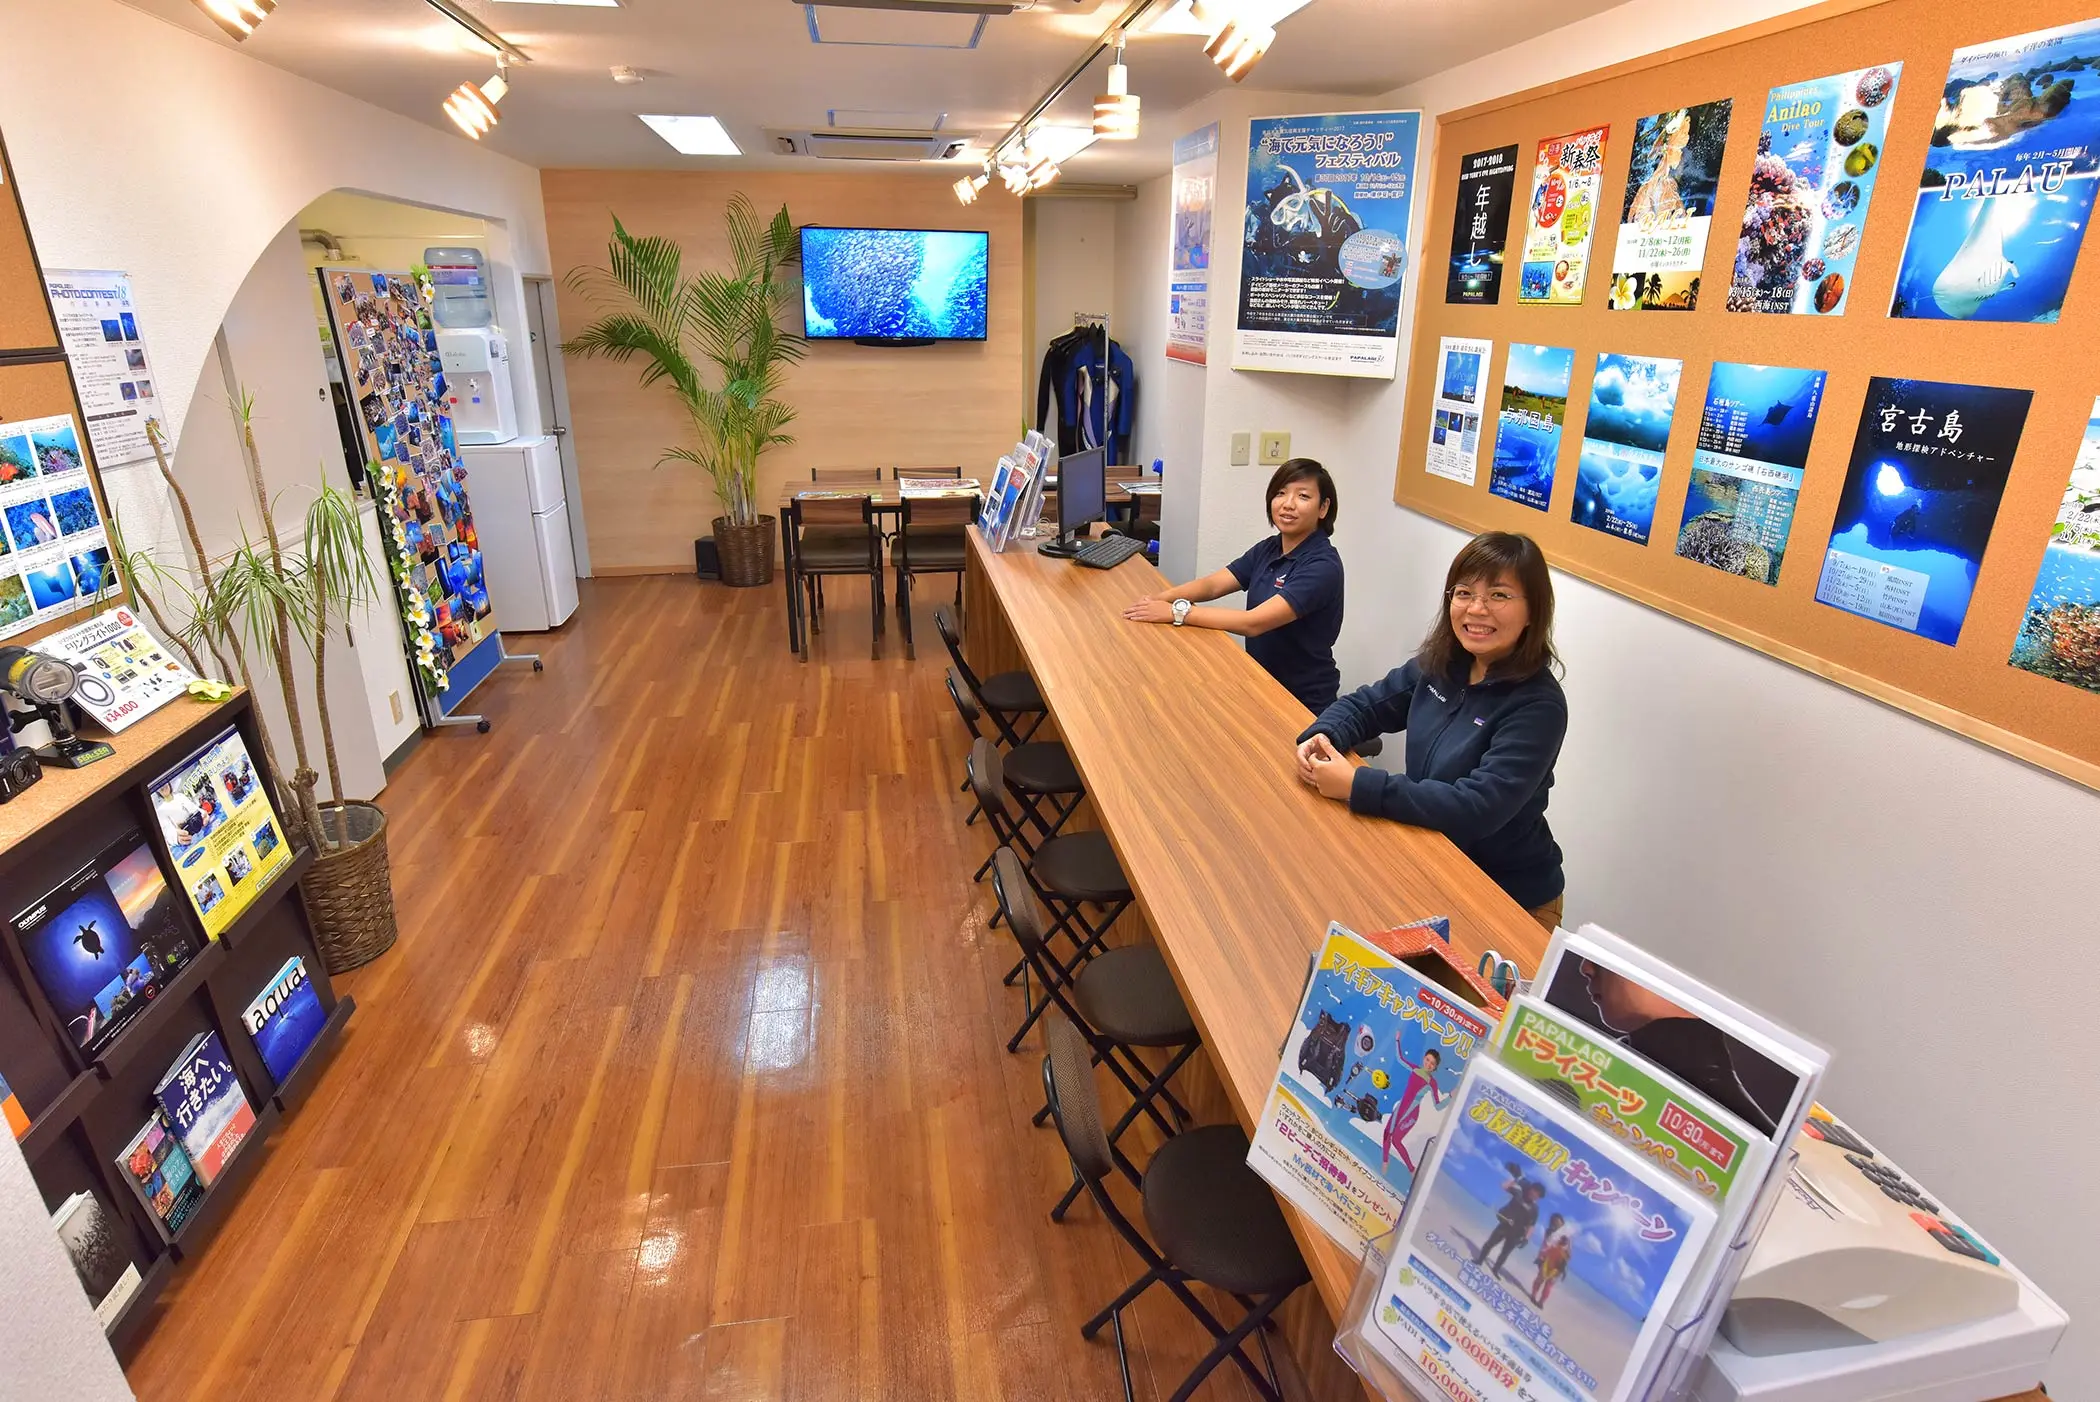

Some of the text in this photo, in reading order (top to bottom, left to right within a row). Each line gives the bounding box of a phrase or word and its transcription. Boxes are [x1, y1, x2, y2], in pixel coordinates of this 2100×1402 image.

[1770, 86, 1819, 102] Philippines
[1766, 100, 1821, 124] Anilao
[1781, 118, 1825, 133] Dive Tour
[1315, 152, 1401, 168] フェスティバル
[1473, 153, 1503, 169] 2017-2018
[1560, 144, 1601, 171] 新春祭
[1939, 160, 2073, 201] PALAU
[1470, 184, 1491, 267] 年越し
[1640, 206, 1697, 234] BALI
[1879, 404, 1964, 444] 宮古島
[1896, 441, 1995, 463] 地形探検アドベンチャー
[18, 905, 48, 929] OLYMPUS
[253, 966, 306, 1031] aqua
[1524, 1012, 1612, 1071] PAPALAGI
[178, 1057, 210, 1095] 海へ
[1513, 1026, 1647, 1115] ドライスーツ
[176, 1061, 232, 1129] 行きたい。
[1590, 1102, 1720, 1196] キャンペーン
